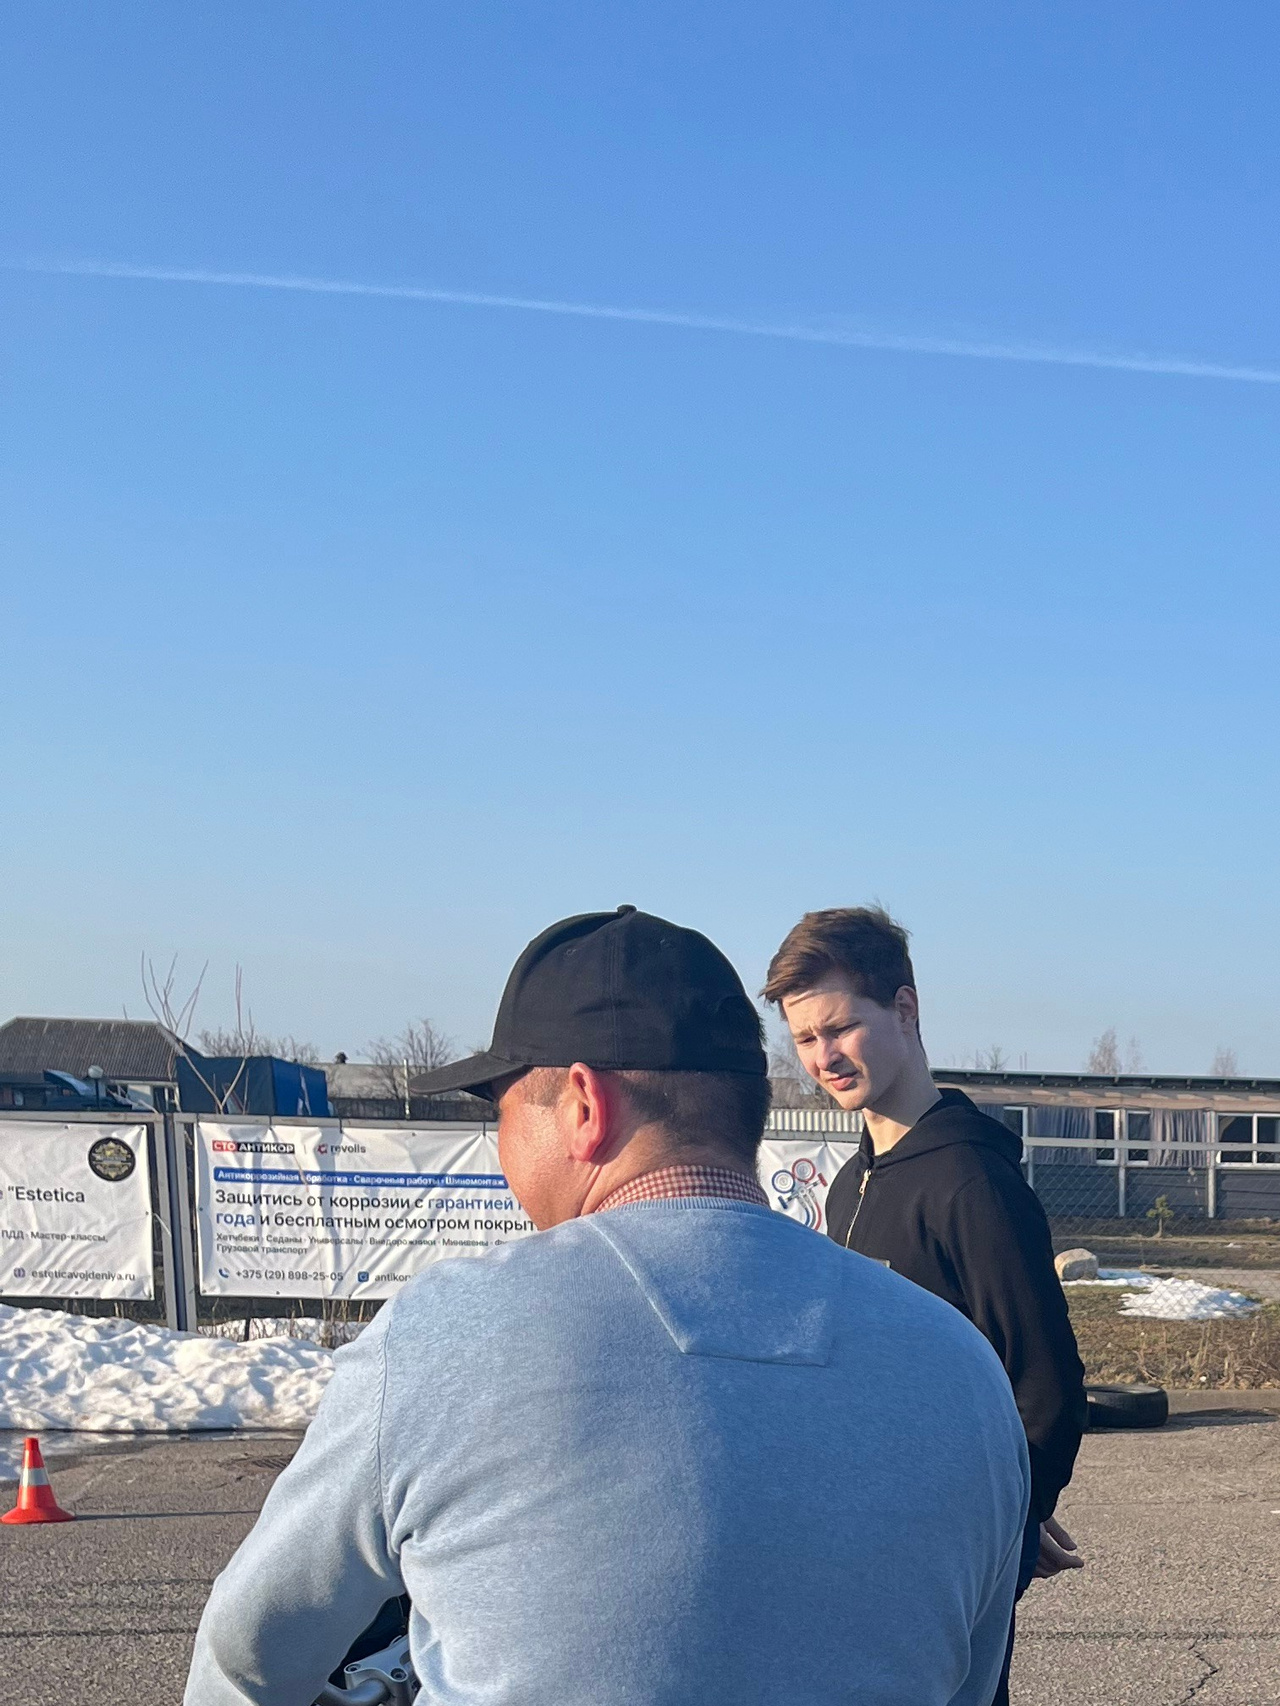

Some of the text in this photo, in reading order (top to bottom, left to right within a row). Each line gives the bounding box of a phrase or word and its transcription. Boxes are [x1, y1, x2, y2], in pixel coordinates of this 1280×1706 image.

[213, 1141, 295, 1154] СТО АНТИКОР
[301, 1172, 348, 1184] бработка
[445, 1177, 505, 1187] Шиномонтаж
[215, 1189, 302, 1207] Защитись
[307, 1195, 324, 1206] от
[330, 1196, 410, 1211] коррозии
[414, 1198, 423, 1209] с
[428, 1197, 514, 1212] гарантией
[216, 1212, 540, 1234] года и бесплатным осмотром покрыт
[266, 1234, 302, 1244] Седаны
[261, 1246, 308, 1256] транспорт
